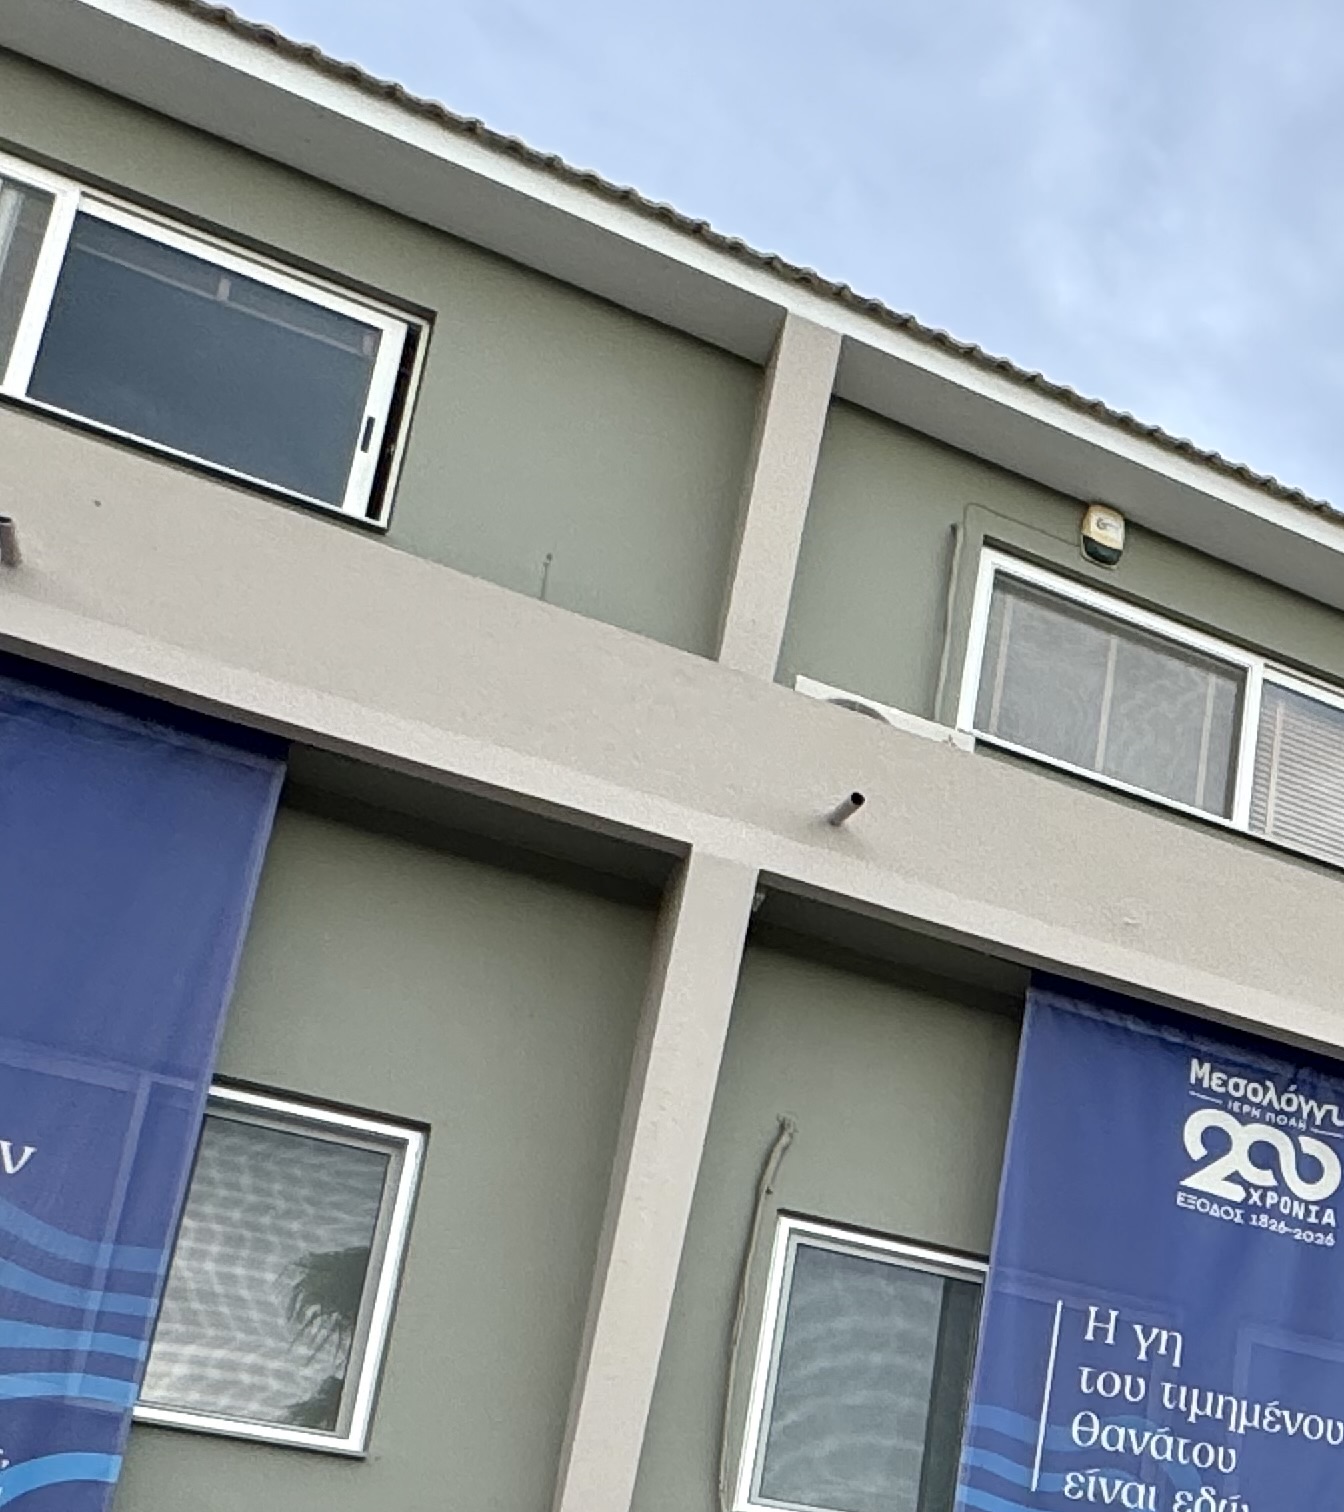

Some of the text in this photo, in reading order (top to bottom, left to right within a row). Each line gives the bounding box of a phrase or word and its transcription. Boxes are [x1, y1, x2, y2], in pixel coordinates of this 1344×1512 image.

[1179, 1108, 1342, 1203] 200
[1176, 1191, 1337, 1247] ΕΞΟΔΟΣ 1826-2026
[1248, 1188, 1337, 1228] ΧΡΟΝΙΑ
[1084, 1306, 1183, 1367] Η γη
[1078, 1366, 1344, 1446] του τιμημένου
[1064, 1467, 1157, 1512] είναι
